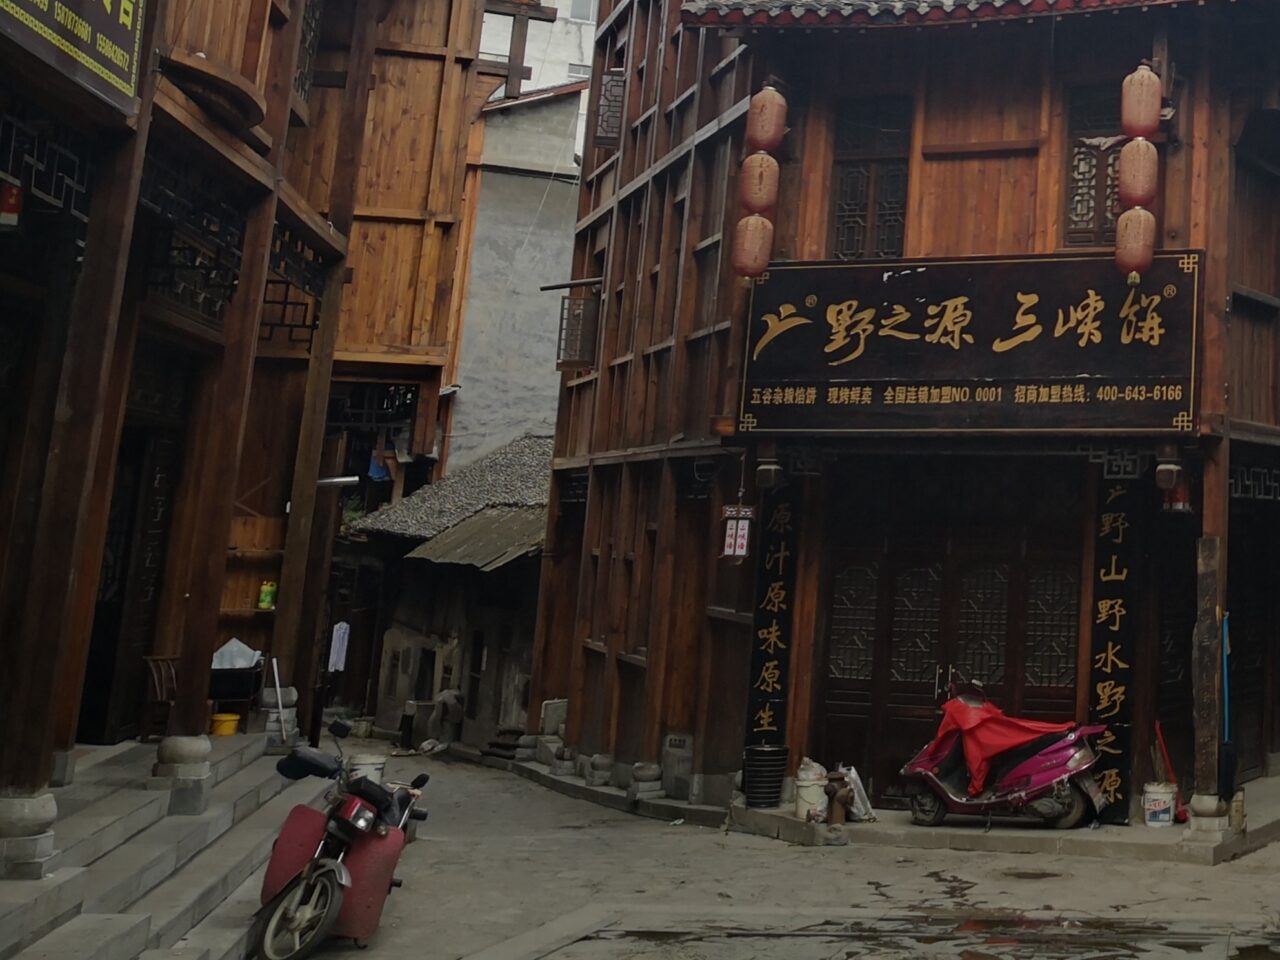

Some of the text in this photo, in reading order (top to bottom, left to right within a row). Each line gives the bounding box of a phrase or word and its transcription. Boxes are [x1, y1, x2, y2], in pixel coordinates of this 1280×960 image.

[992, 288, 1165, 353] 三峡饼
[1096, 384, 1182, 401] 400-643-6166
